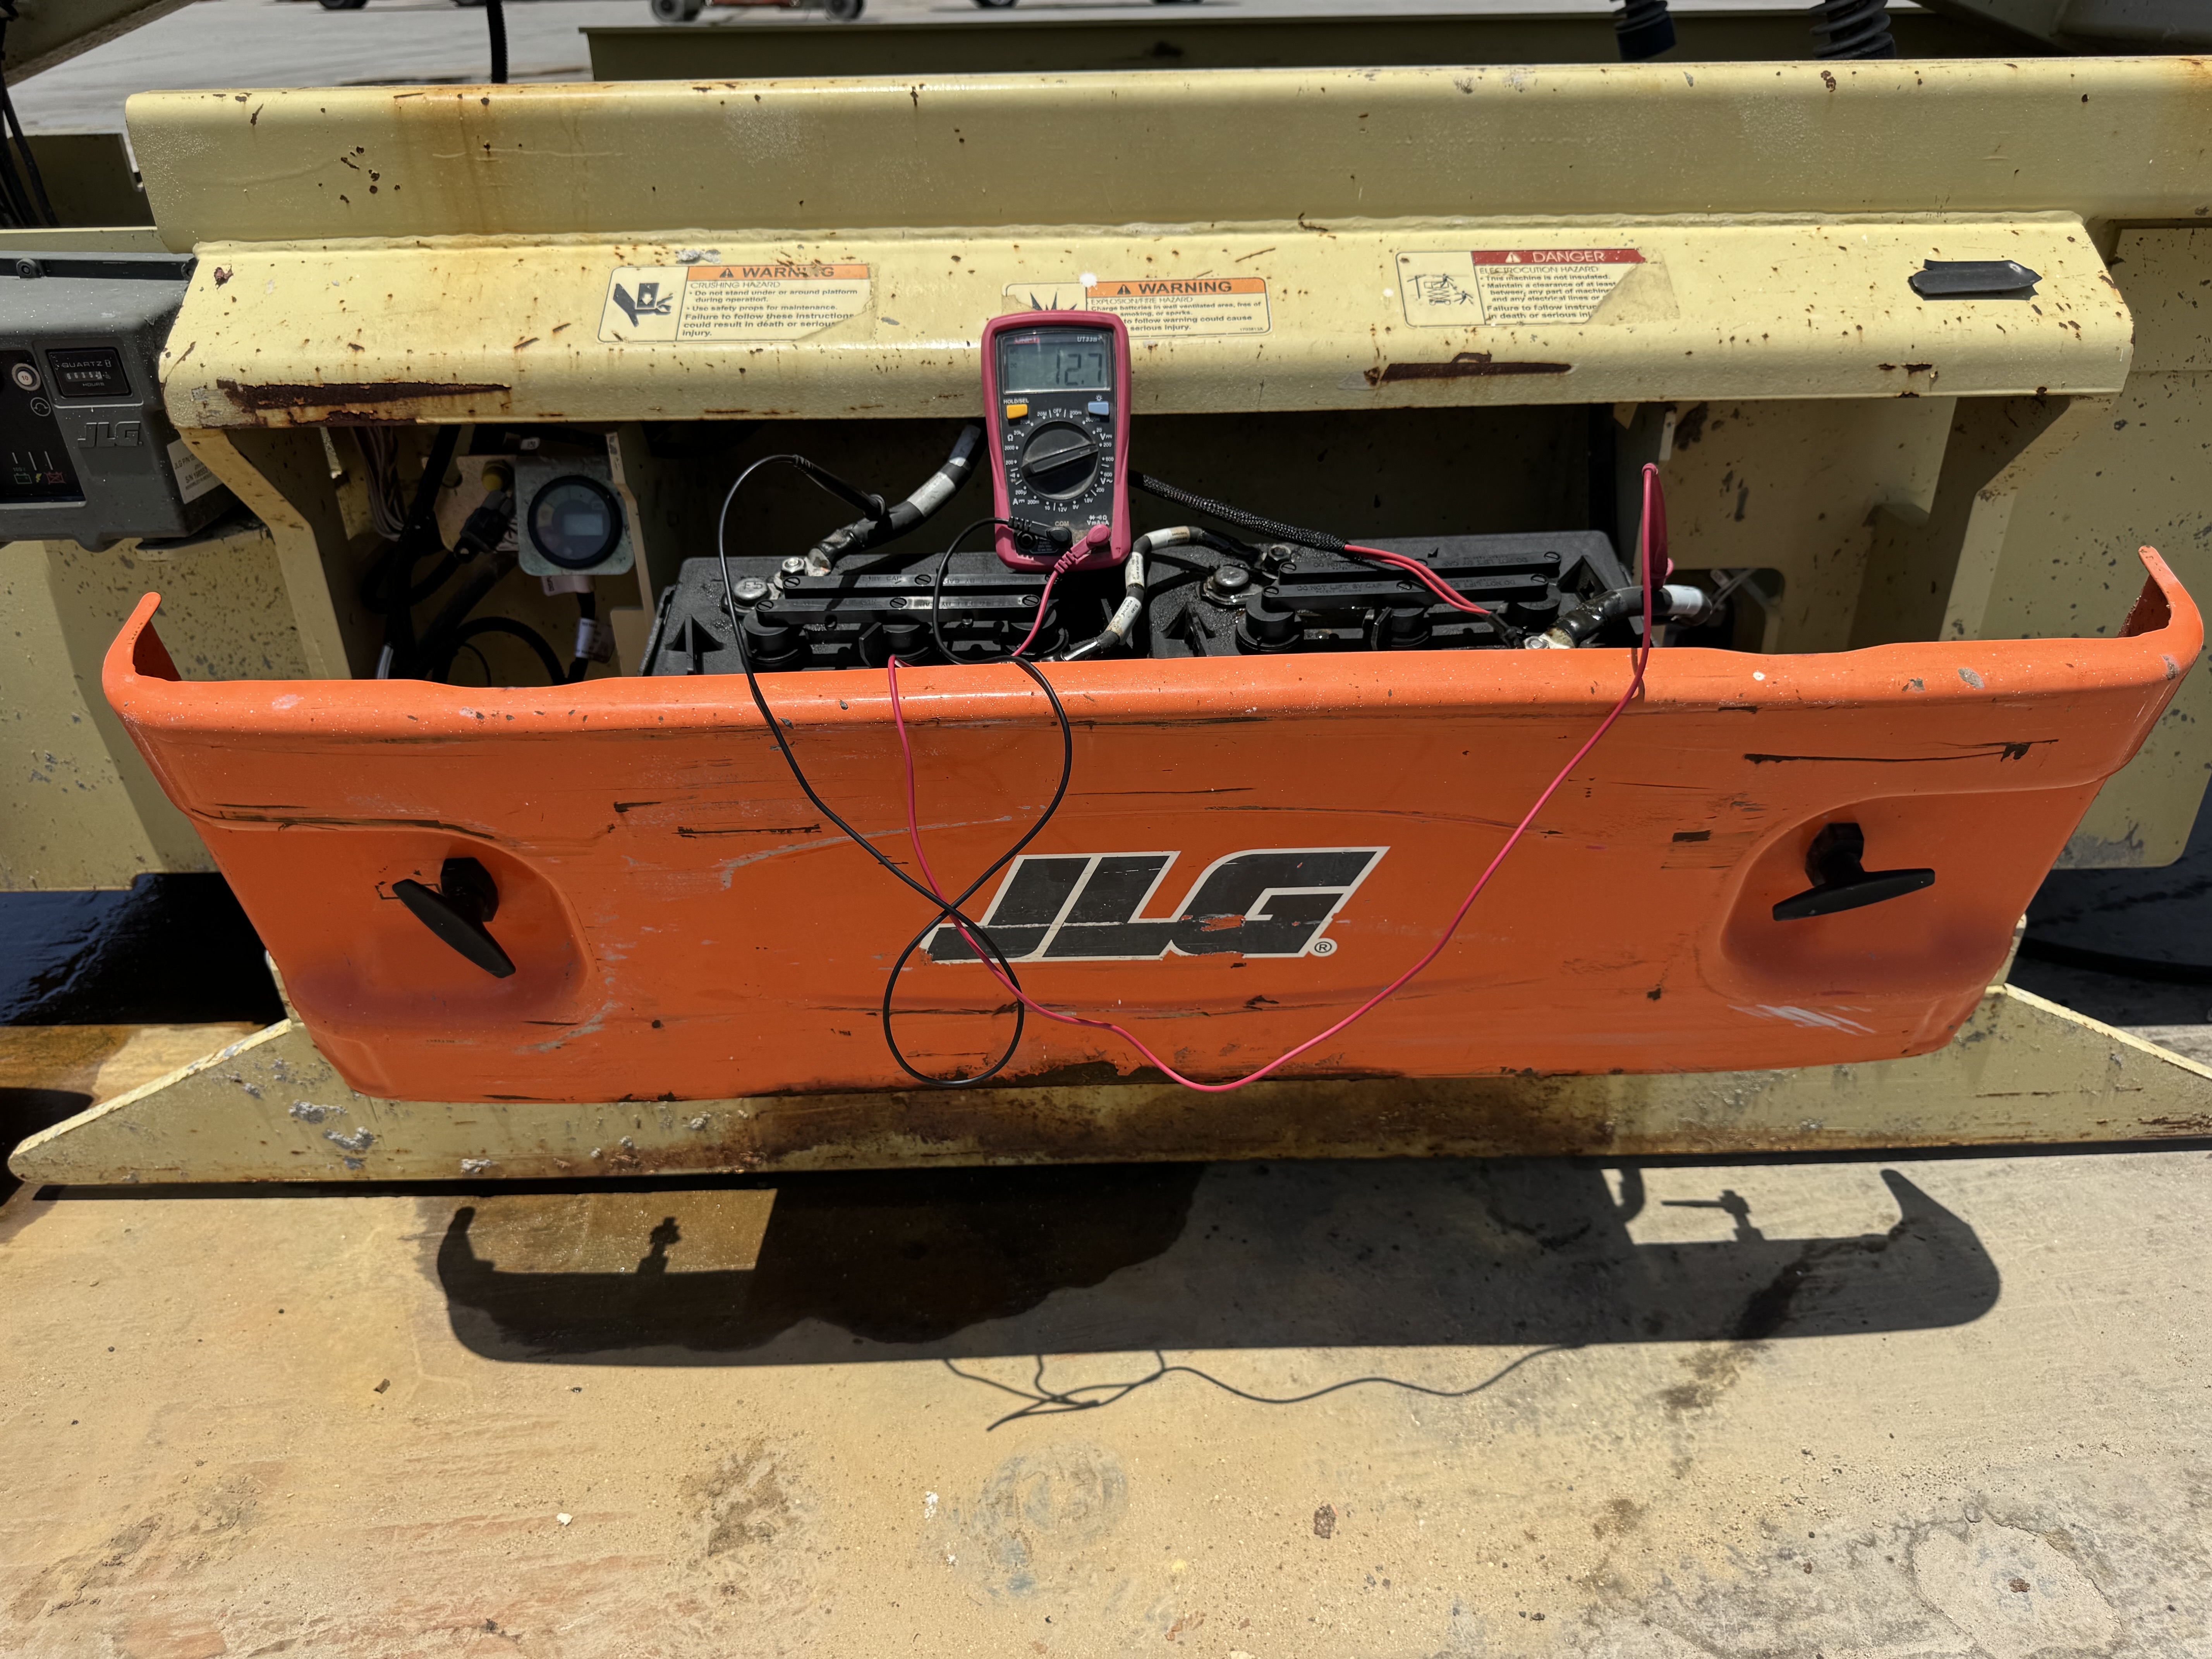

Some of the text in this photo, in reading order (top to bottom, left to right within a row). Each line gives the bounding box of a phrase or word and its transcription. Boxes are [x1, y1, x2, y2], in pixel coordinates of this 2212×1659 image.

[1532, 251, 1605, 263] DANGER
[1138, 281, 1232, 294] WARNING
[1091, 297, 1156, 305] EXPLOSION/FIRE
[1055, 353, 1103, 386] 12.7
[77, 421, 142, 448] JLG
[919, 846, 1390, 964] JLG
